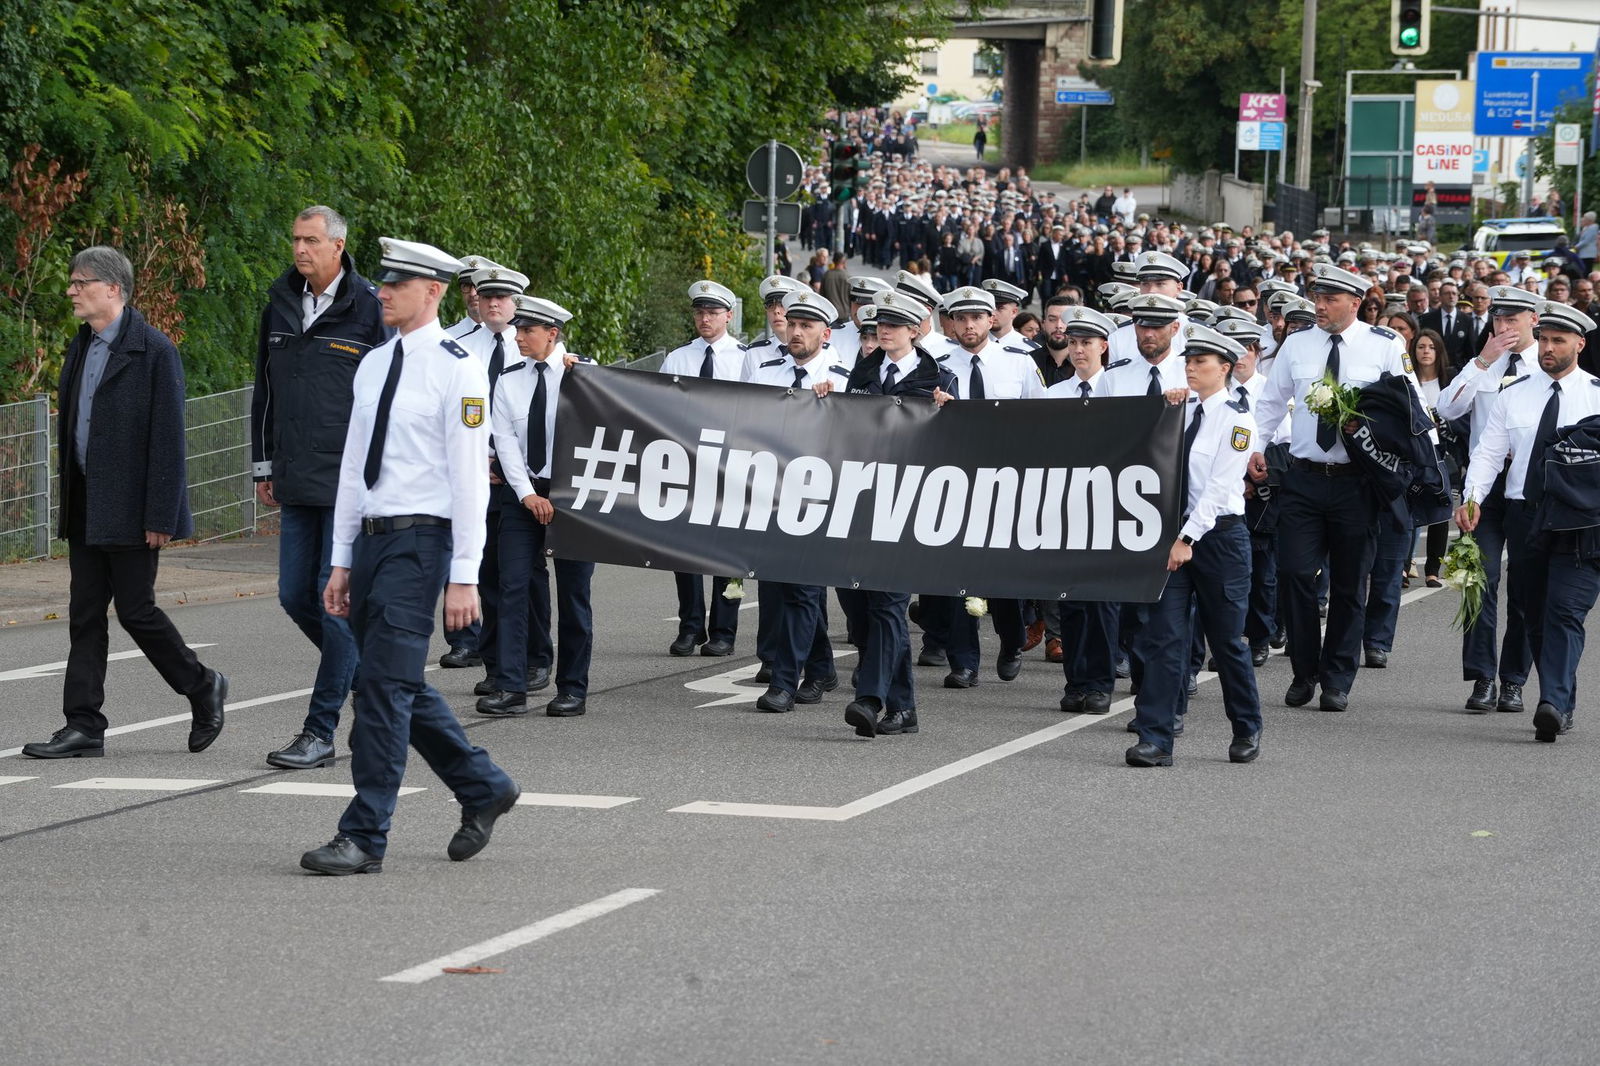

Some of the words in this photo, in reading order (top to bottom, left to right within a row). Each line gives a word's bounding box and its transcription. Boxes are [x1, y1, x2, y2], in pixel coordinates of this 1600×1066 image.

[1483, 90, 1529, 100] Luxembourg
[1247, 94, 1279, 109] KFC
[1483, 99, 1529, 107] Neunkirchen
[1420, 111, 1472, 123] MEDUSA
[570, 425, 1163, 552] #einervonuns
